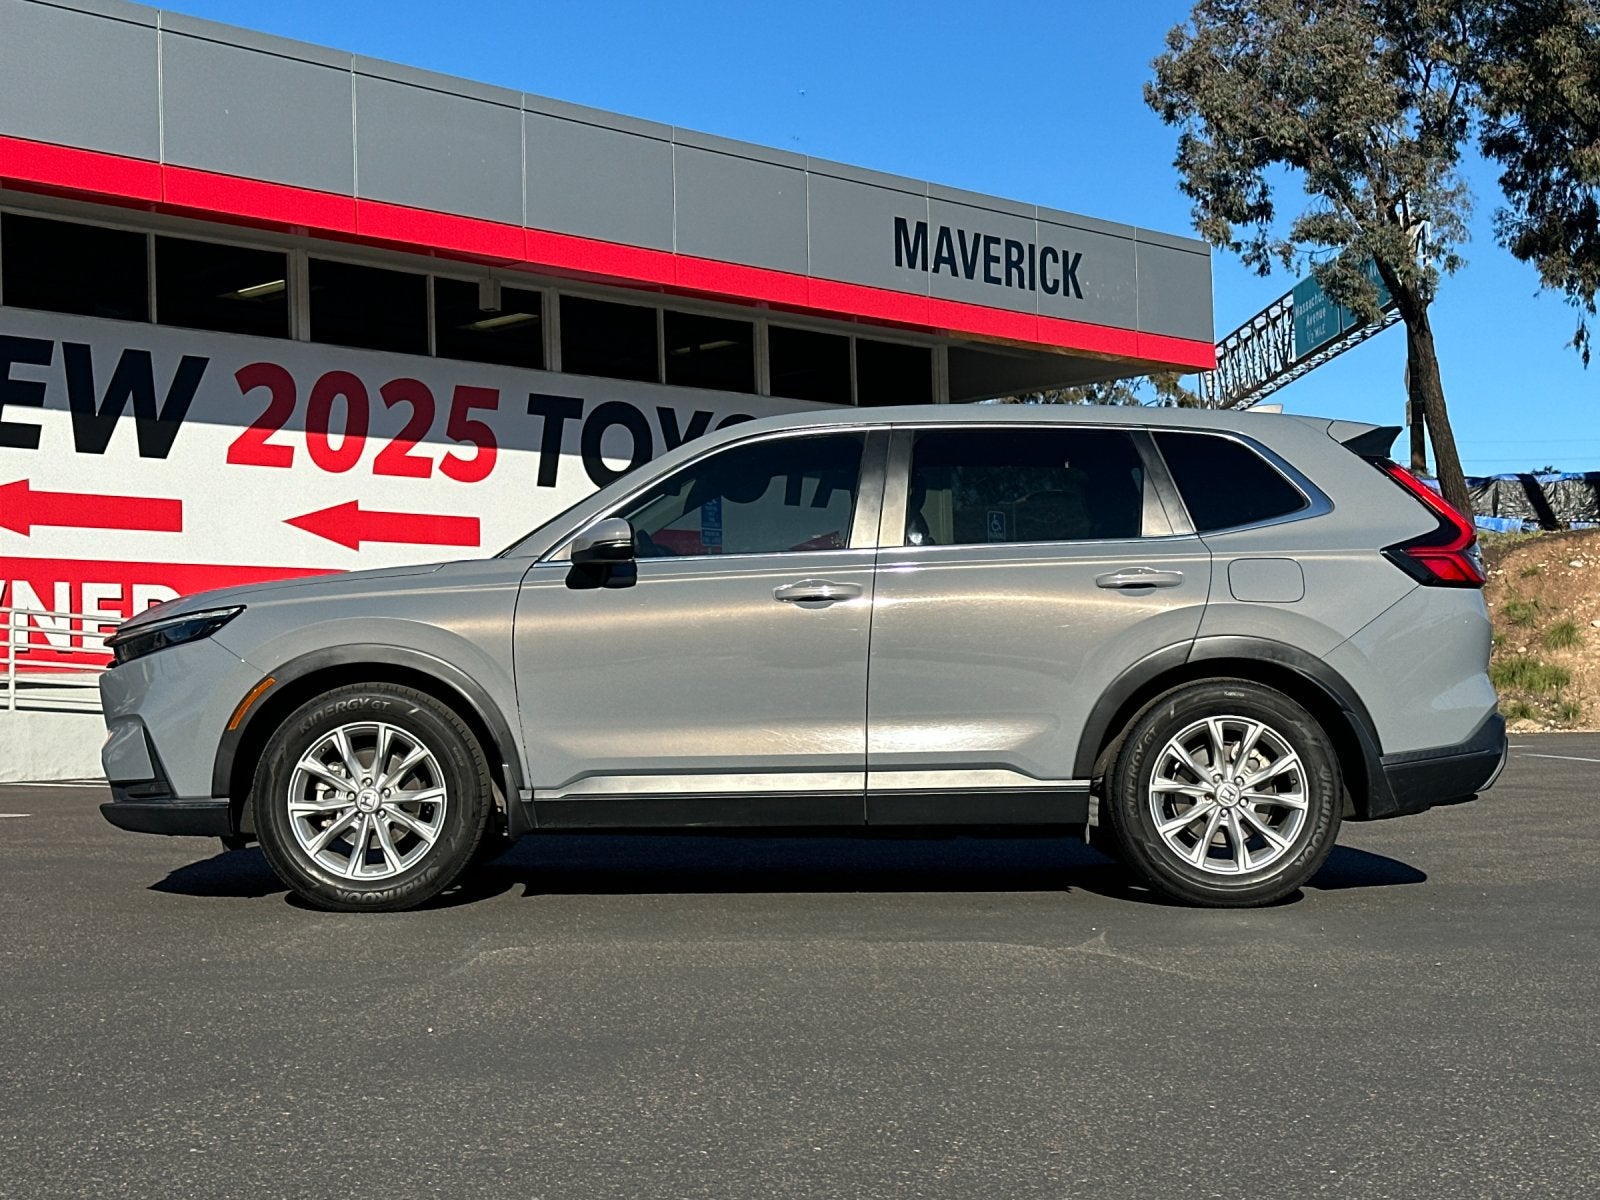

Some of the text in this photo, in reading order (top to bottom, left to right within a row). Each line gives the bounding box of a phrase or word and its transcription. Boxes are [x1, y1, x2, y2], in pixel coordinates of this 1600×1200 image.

[894, 216, 1083, 299] MAVERICK
[0, 335, 210, 460] EW
[226, 361, 500, 483] 2025
[371, 700, 391, 711] GT
